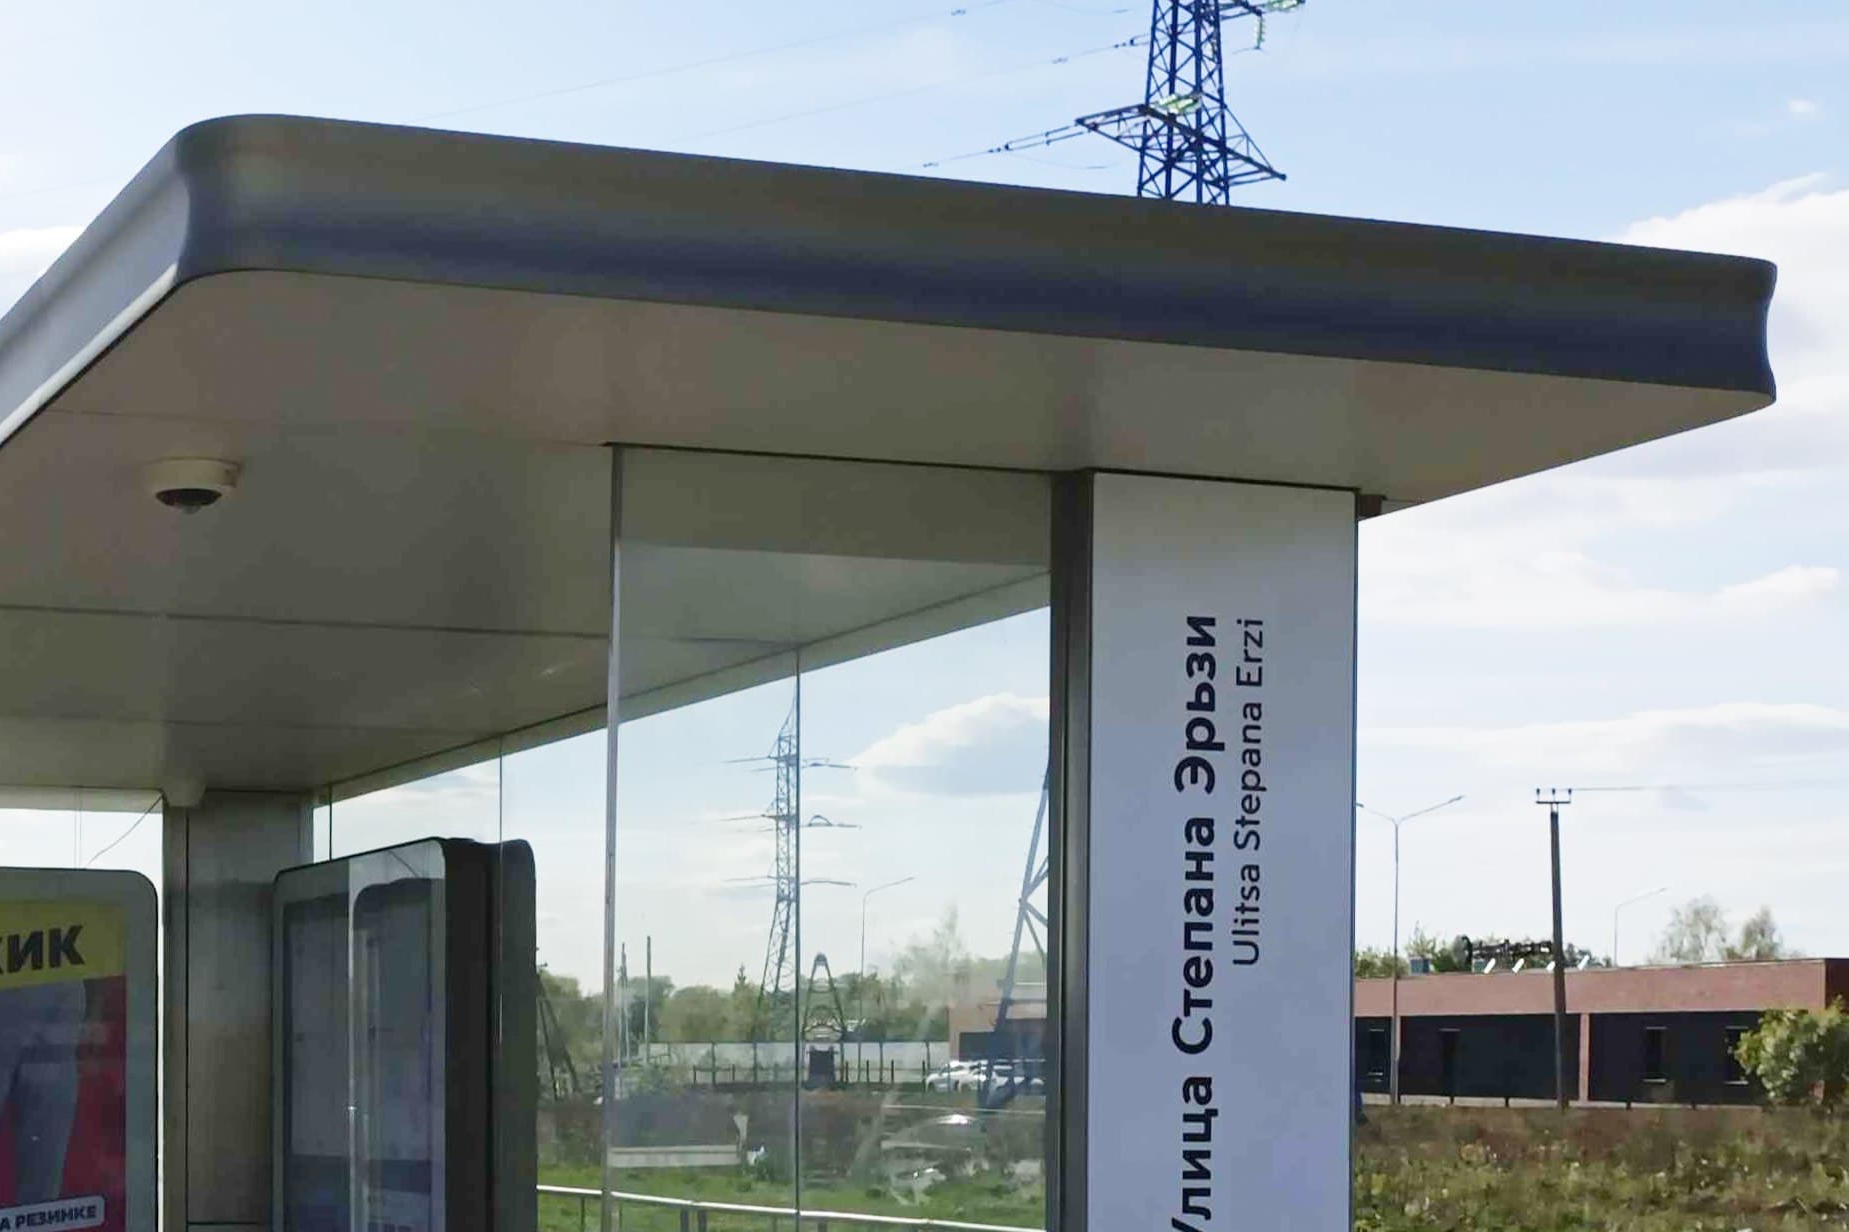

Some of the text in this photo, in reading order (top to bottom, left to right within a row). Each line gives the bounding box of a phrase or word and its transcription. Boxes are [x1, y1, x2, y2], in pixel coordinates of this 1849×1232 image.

[1173, 615, 1226, 795] Эрьзи
[1231, 618, 1267, 965] Ulitsa Stepana Erzi
[1171, 816, 1216, 1055] Степана
[14, 1204, 97, 1230] РЕЗИНКЕ
